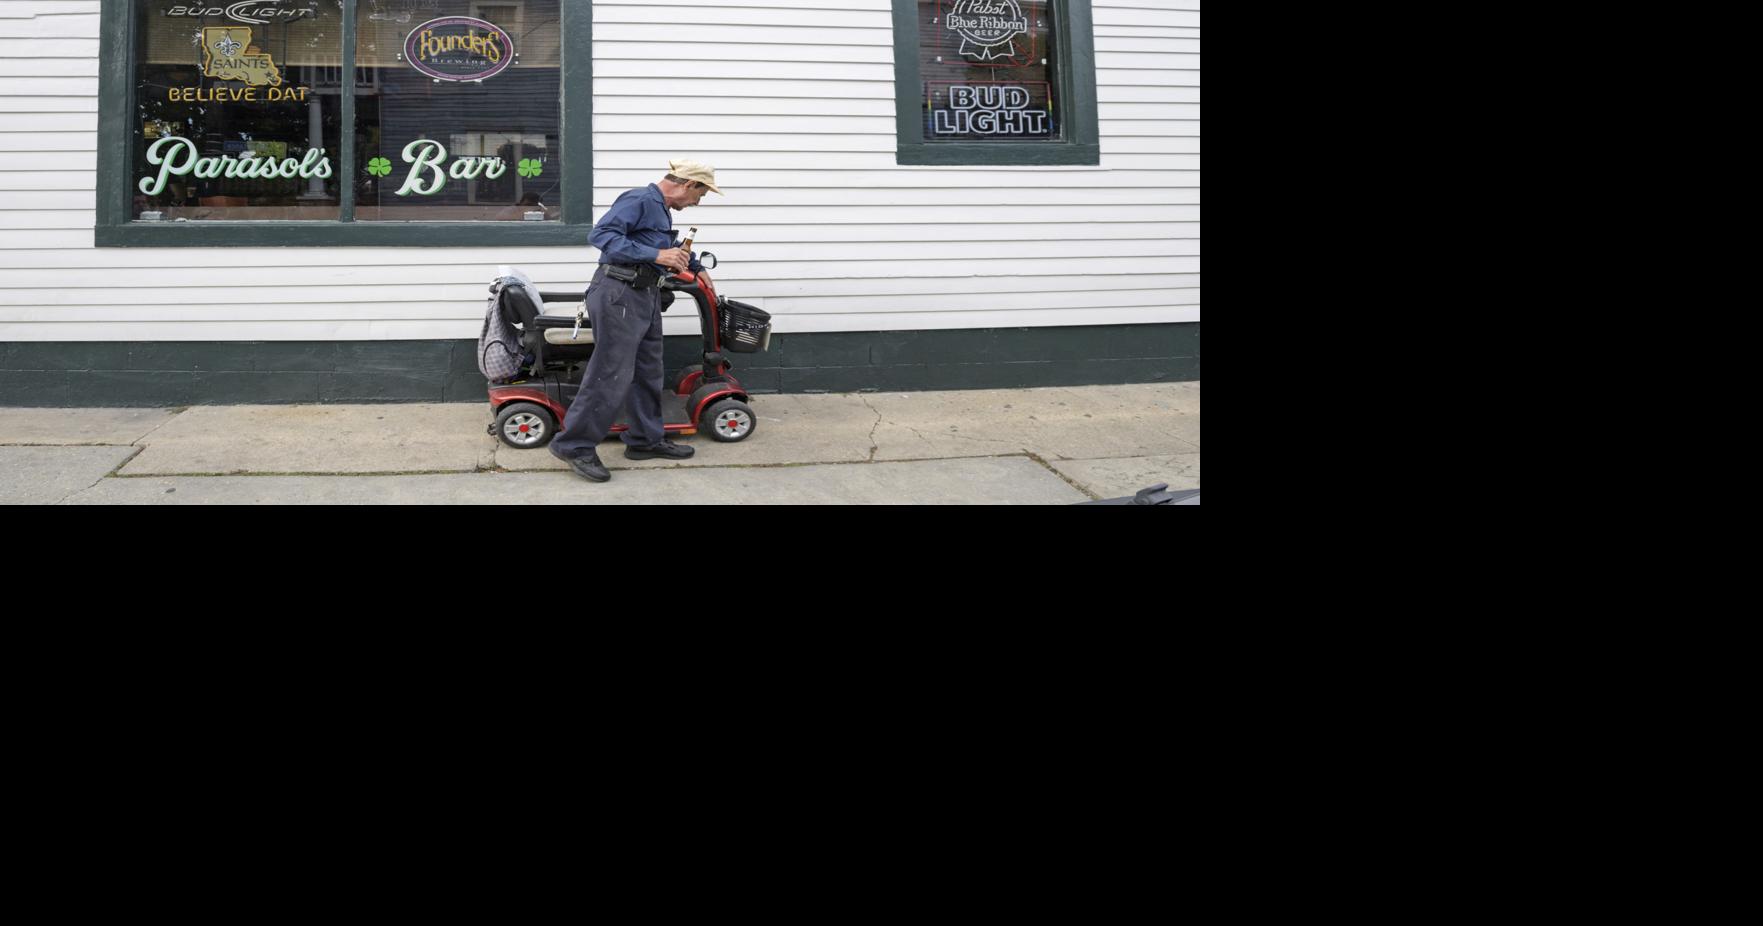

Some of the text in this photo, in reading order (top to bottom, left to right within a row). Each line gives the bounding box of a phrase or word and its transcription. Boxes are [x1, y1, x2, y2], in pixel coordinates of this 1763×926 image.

[168, 5, 313, 17] BUD LIGHT
[967, 0, 1008, 15] Pabst
[950, 16, 1024, 30] Blue Ribbon
[213, 58, 269, 69] SAINTS
[168, 86, 309, 101] BELIEVE DAT
[950, 85, 1030, 110] BUD
[138, 136, 507, 197] Parasol's Bar
